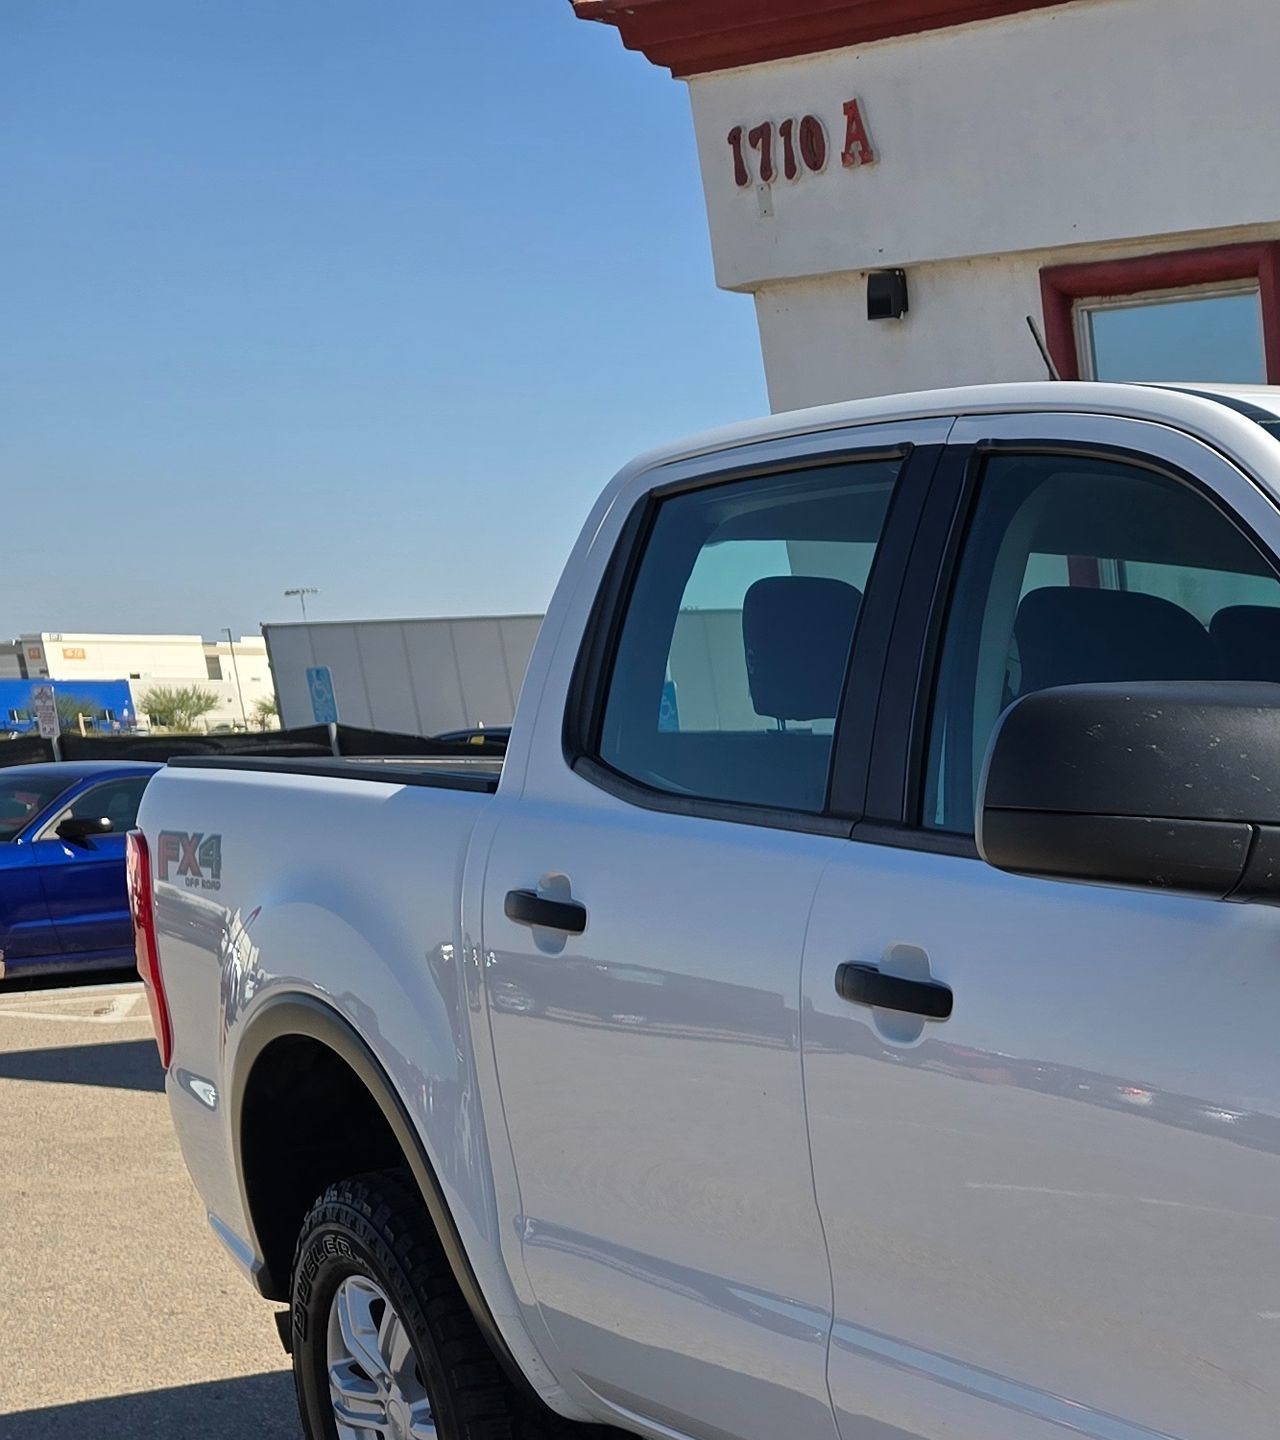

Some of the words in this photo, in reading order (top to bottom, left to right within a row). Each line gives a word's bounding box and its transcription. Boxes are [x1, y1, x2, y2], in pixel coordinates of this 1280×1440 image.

[727, 113, 830, 187] 1710
[840, 97, 876, 168] A
[157, 829, 223, 881] FX4
[184, 877, 201, 888] OFF
[201, 879, 222, 892] ROAD
[293, 1233, 356, 1342] DUELER
